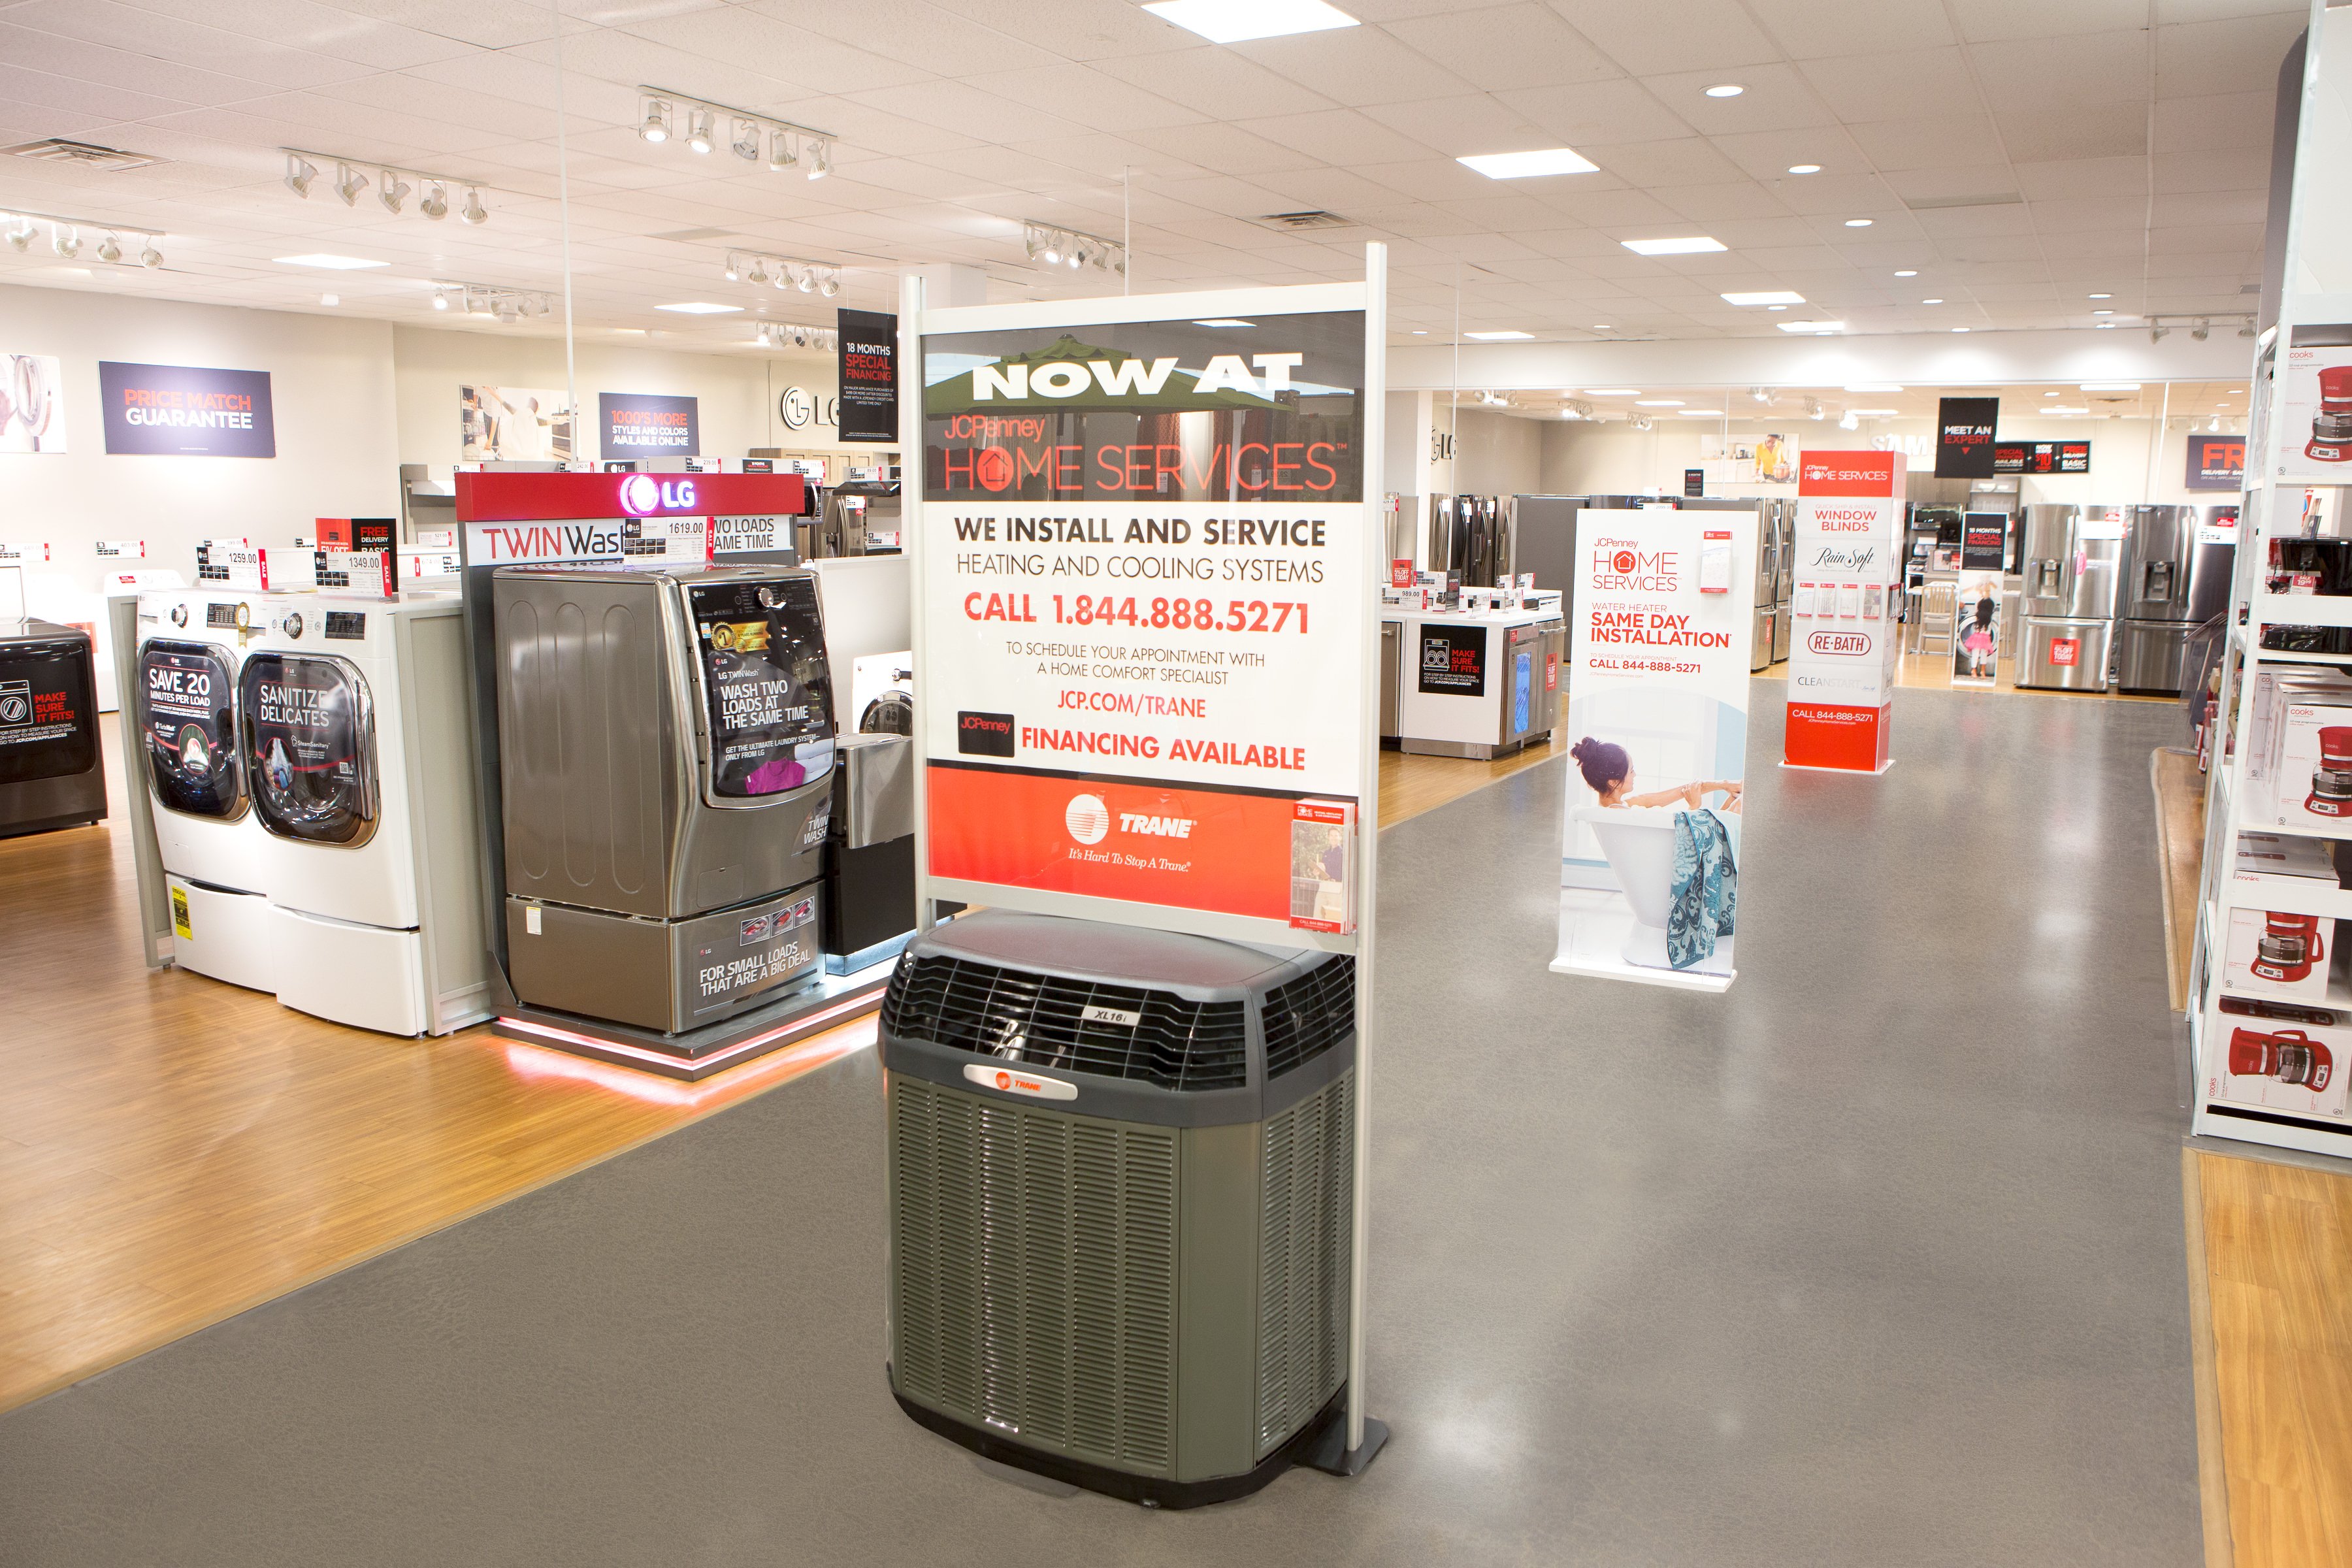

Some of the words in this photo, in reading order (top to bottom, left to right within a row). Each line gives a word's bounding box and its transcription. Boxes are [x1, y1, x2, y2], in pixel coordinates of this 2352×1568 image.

[847, 342, 855, 352] 18
[857, 344, 890, 355] MONTHS
[846, 353, 890, 369] SPECIAL
[846, 368, 891, 381] FINANCING
[972, 357, 1179, 400] NOW
[1193, 353, 1302, 393] AT
[125, 389, 183, 408] PRICE
[188, 393, 251, 410] MATCH
[125, 408, 253, 429] GUARANTEE
[612, 410, 651, 425] 1000'S
[653, 413, 687, 426] MORE
[612, 425, 640, 434] STYLES
[642, 427, 658, 435] AND
[944, 415, 1046, 442] JCPenney
[1944, 426, 1974, 434] MEET
[1974, 426, 1991, 434] AN
[613, 435, 657, 445] AVAILABLE
[659, 436, 689, 446] ONLINE
[1944, 435, 1991, 444] EXPERT
[945, 444, 1083, 491] HOME
[1805, 470, 1836, 480] HOME
[1838, 471, 1887, 480] SERVICES
[664, 481, 696, 508] LG
[1816, 510, 1876, 520] WINDOW
[361, 527, 388, 536] FREE
[670, 523, 703, 533] 1619.00
[736, 519, 774, 532] LOADS
[955, 517, 996, 542] WE
[1007, 517, 1113, 544] INSTALL
[1123, 519, 1190, 544] AND
[1204, 519, 1325, 546] SERVICE
[1822, 522, 1869, 531] BLINDS
[747, 534, 774, 548] TIME
[1595, 538, 1639, 549] JCPenney
[229, 553, 256, 563] 1259.00
[350, 557, 379, 568] 1349.00
[1593, 551, 1678, 574] HOME
[1810, 547, 1845, 568] Rain
[1844, 547, 1874, 572] Soft
[958, 554, 1044, 576] HEATING
[1053, 555, 1099, 578] AND
[1107, 557, 1213, 580] COOLING
[1222, 558, 1323, 583] SYSTEMS
[1593, 575, 1677, 591] SERVICES
[964, 593, 1037, 623] CALL
[1053, 594, 1308, 634] 1.844.888.5271
[1592, 602, 1625, 611] WATER
[1592, 612, 1644, 627] SAME
[1651, 615, 1690, 629] DAY
[1007, 642, 1022, 654] TO
[1026, 642, 1086, 659] SCHEDULE
[1091, 645, 1127, 661] YOUR
[1131, 647, 1225, 666] APPOINTMENT
[1230, 653, 1265, 667] WITH
[1037, 662, 1046, 675] A
[1051, 662, 1088, 677] HOME
[1092, 664, 1154, 681] COMFORT
[1160, 668, 1228, 685] SPECIALIST
[1590, 659, 1619, 668] CALL
[1623, 661, 1700, 673] 844-888-5271
[150, 668, 183, 692] SAVE
[187, 673, 210, 695] 20
[721, 683, 758, 700] WASH
[760, 679, 788, 695] TWO
[35, 692, 67, 704] MAKE
[150, 690, 174, 702] MINUTES
[176, 694, 189, 704] PER
[190, 696, 210, 706] LOAD
[261, 685, 327, 708] SANITIZE
[1058, 691, 1206, 718] JCP.COM/TRANE
[36, 702, 65, 713] SURE
[723, 697, 762, 715] LOADS
[765, 695, 778, 710] AT
[37, 714, 46, 723] IT
[50, 710, 74, 721] FITS!
[261, 705, 329, 727] DELICATES
[723, 714, 747, 729] THE
[751, 710, 783, 727] SAME
[785, 706, 809, 721] TIME
[1817, 711, 1872, 721] 844-888-5271
[960, 717, 1011, 734] JCPenney
[16, 733, 67, 743] JCP.COM/APPLIANCES
[749, 741, 774, 750] ULTIMATE
[775, 737, 797, 745] LAUNDRY
[1022, 727, 1160, 758] FINANCING
[1169, 739, 1305, 770] AVAILABLE
[809, 815, 829, 831] TWIN
[804, 826, 828, 845] WASH
[1068, 848, 1082, 859] It's
[1084, 850, 1109, 863] Hard
[1112, 853, 1122, 864] To
[1125, 854, 1146, 869] Stop
[1148, 858, 1156, 868] A
[700, 965, 725, 983] FOR
[727, 955, 765, 975] SMALL
[768, 941, 798, 964] LOADS
[700, 977, 732, 997] THAT
[734, 970, 757, 987] ARE
[760, 966, 768, 979] A
[771, 960, 786, 976] BIG
[788, 949, 810, 970] DEAL
[1095, 1011, 1126, 1022] XL16i
[1015, 1080, 1041, 1091] TRANE
